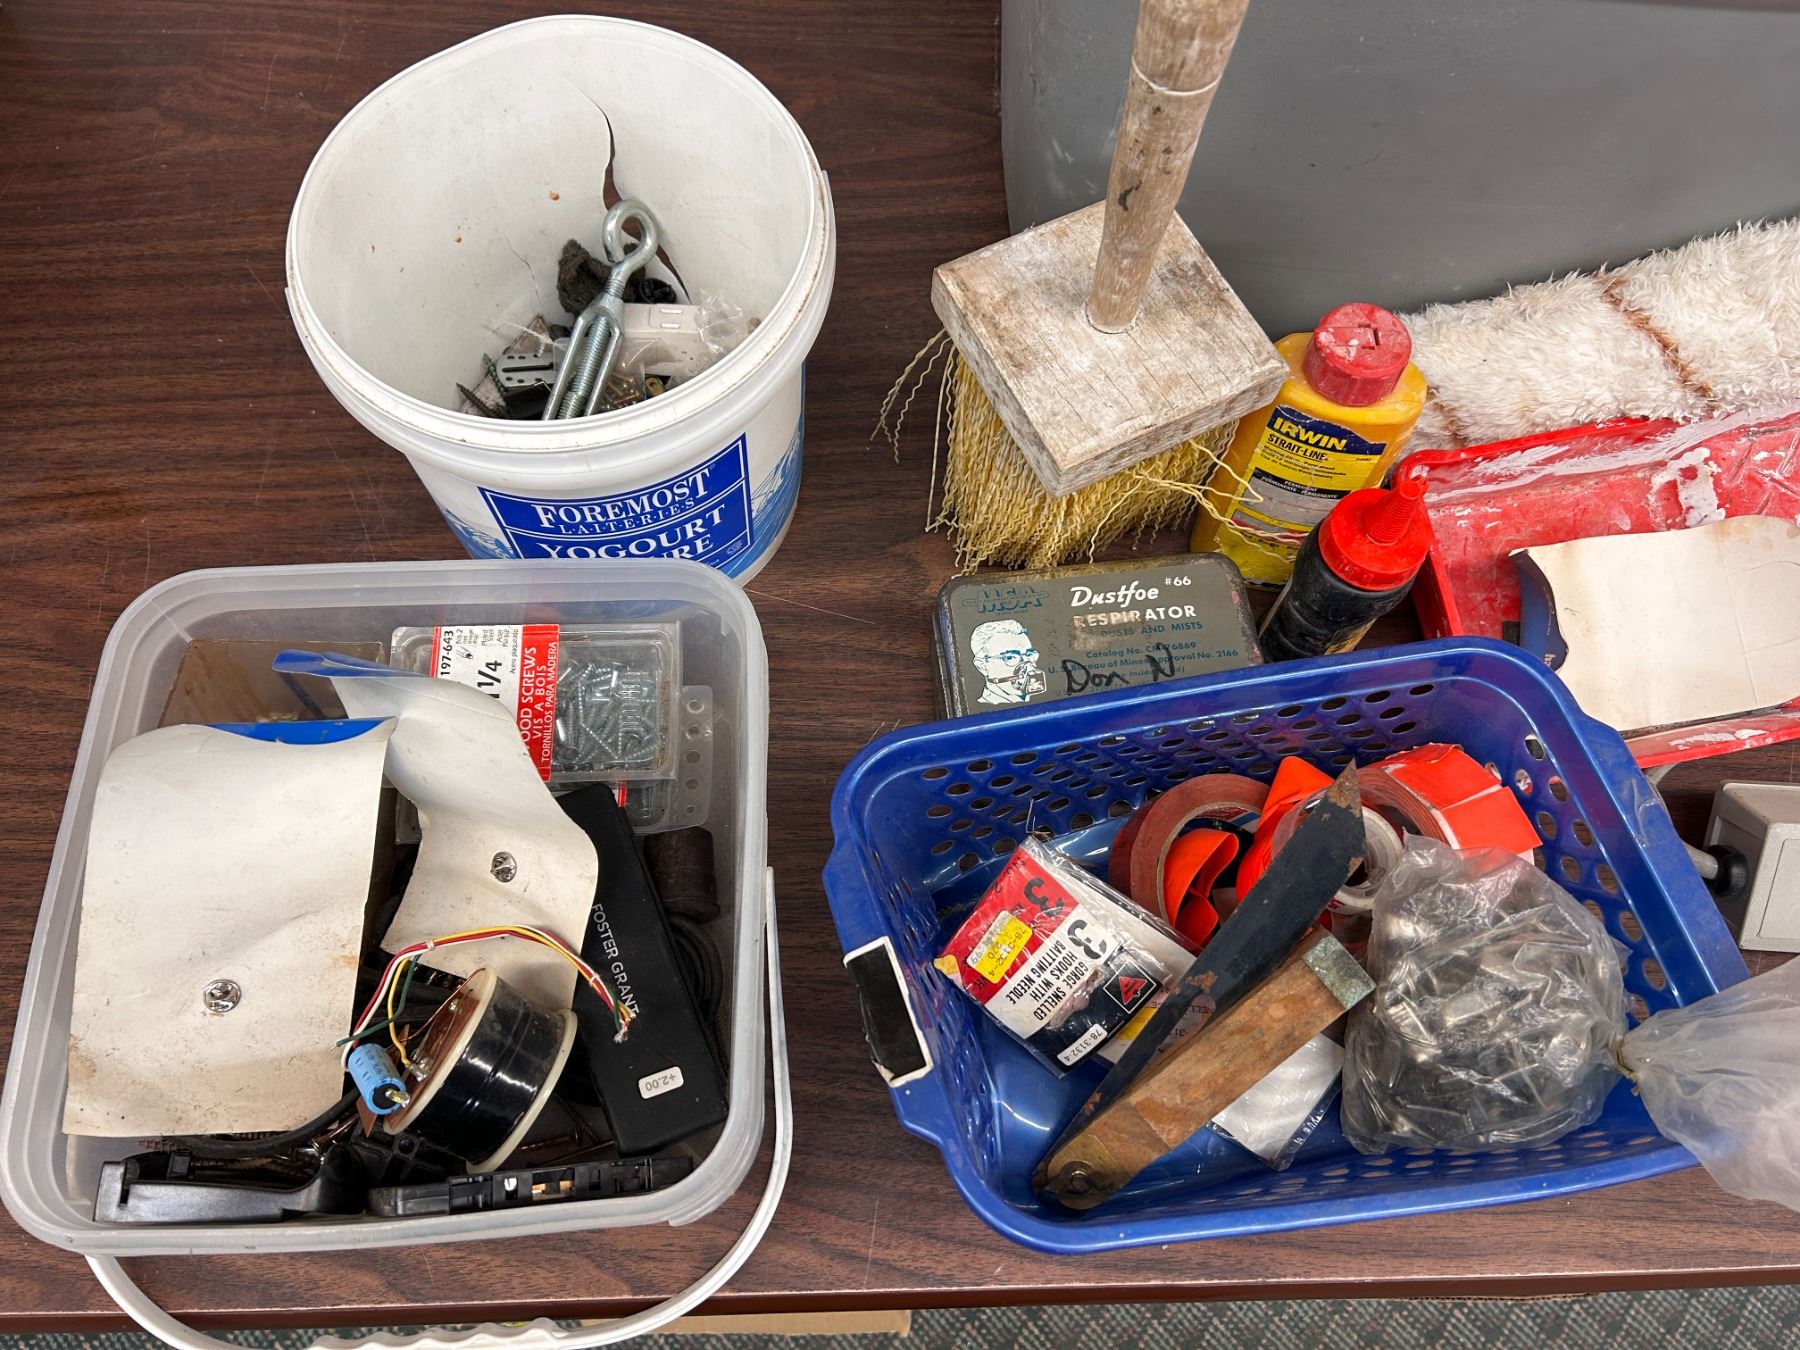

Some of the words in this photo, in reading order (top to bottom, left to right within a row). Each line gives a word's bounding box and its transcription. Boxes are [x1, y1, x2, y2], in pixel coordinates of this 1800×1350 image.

[1267, 433, 1328, 461] STRAIT-LINE
[1273, 416, 1347, 450] IRWIN
[531, 467, 711, 528] FOREMOST
[536, 504, 725, 559] YOGOURT
[1069, 580, 1160, 608] Dustfoe
[1163, 575, 1192, 588] #66
[1072, 605, 1197, 629] RESPIRATOR
[1141, 624, 1165, 635] AND
[1171, 621, 1203, 632] MISTS
[440, 630, 454, 676] 197-643
[546, 641, 558, 681] MADERA
[1086, 647, 1124, 660] Catalog
[1215, 649, 1239, 658] 2166
[521, 646, 537, 704] SCREWS
[535, 664, 547, 696] BOIS
[1061, 659, 1131, 696] Don
[534, 702, 544, 711] A
[545, 683, 555, 707] PARA
[519, 707, 532, 748] OOD
[532, 718, 543, 739] VIS
[541, 710, 553, 763] TORNILLOS
[1023, 877, 1065, 917] 3
[1067, 919, 1107, 960] 3
[592, 903, 618, 960] FOSTER
[611, 961, 640, 1018] GRANT
[1030, 940, 1067, 978] BAITTING
[1050, 951, 1078, 980] HOOKS
[1062, 961, 1089, 990] GORGE
[1005, 973, 1036, 1005] NEEDLE
[1029, 977, 1054, 1002] WITH
[1033, 986, 1067, 1021] SNELLED
[645, 1073, 676, 1092] +2.00
